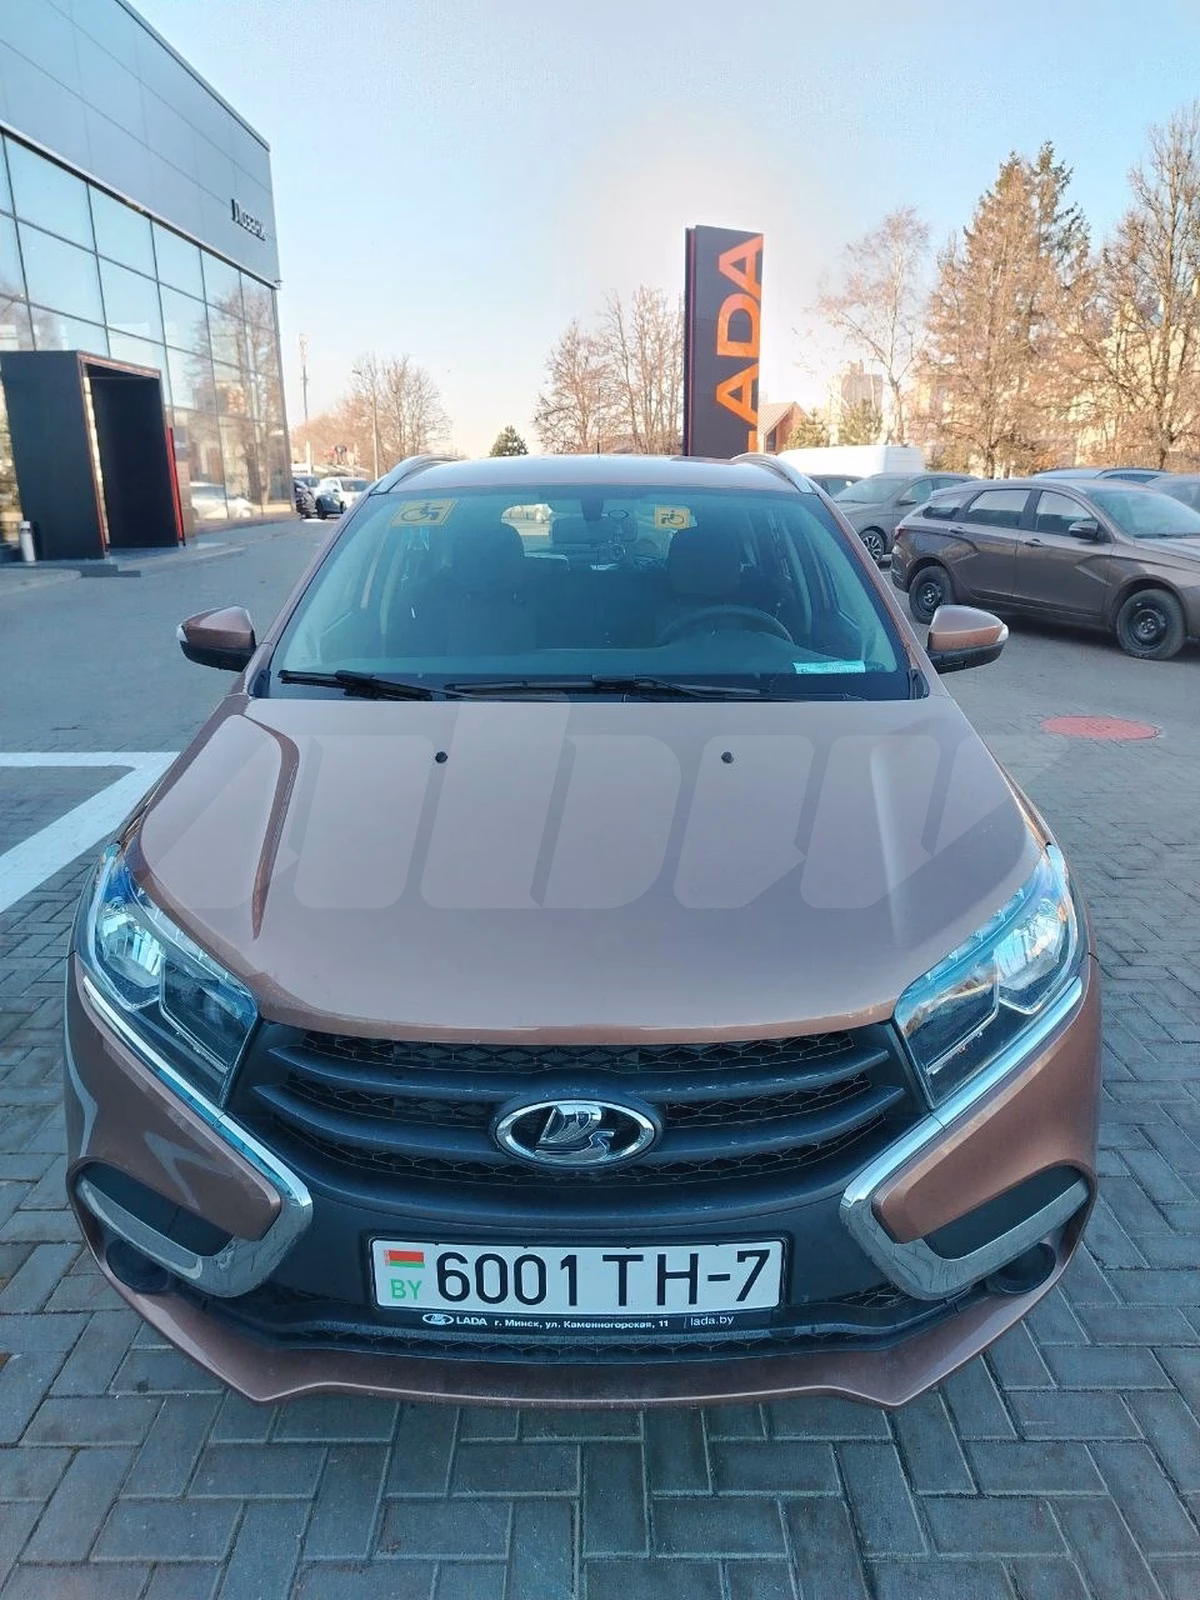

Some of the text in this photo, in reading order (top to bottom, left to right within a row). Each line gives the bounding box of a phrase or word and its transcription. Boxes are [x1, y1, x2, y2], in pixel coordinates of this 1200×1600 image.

[715, 234, 764, 453] ADA
[390, 1278, 422, 1300] BY
[436, 1252, 578, 1306] 6001
[456, 1316, 488, 1326] LADA
[505, 1319, 543, 1329] Минск,
[545, 1320, 561, 1329] ул.
[690, 1315, 735, 1327] lada.by
